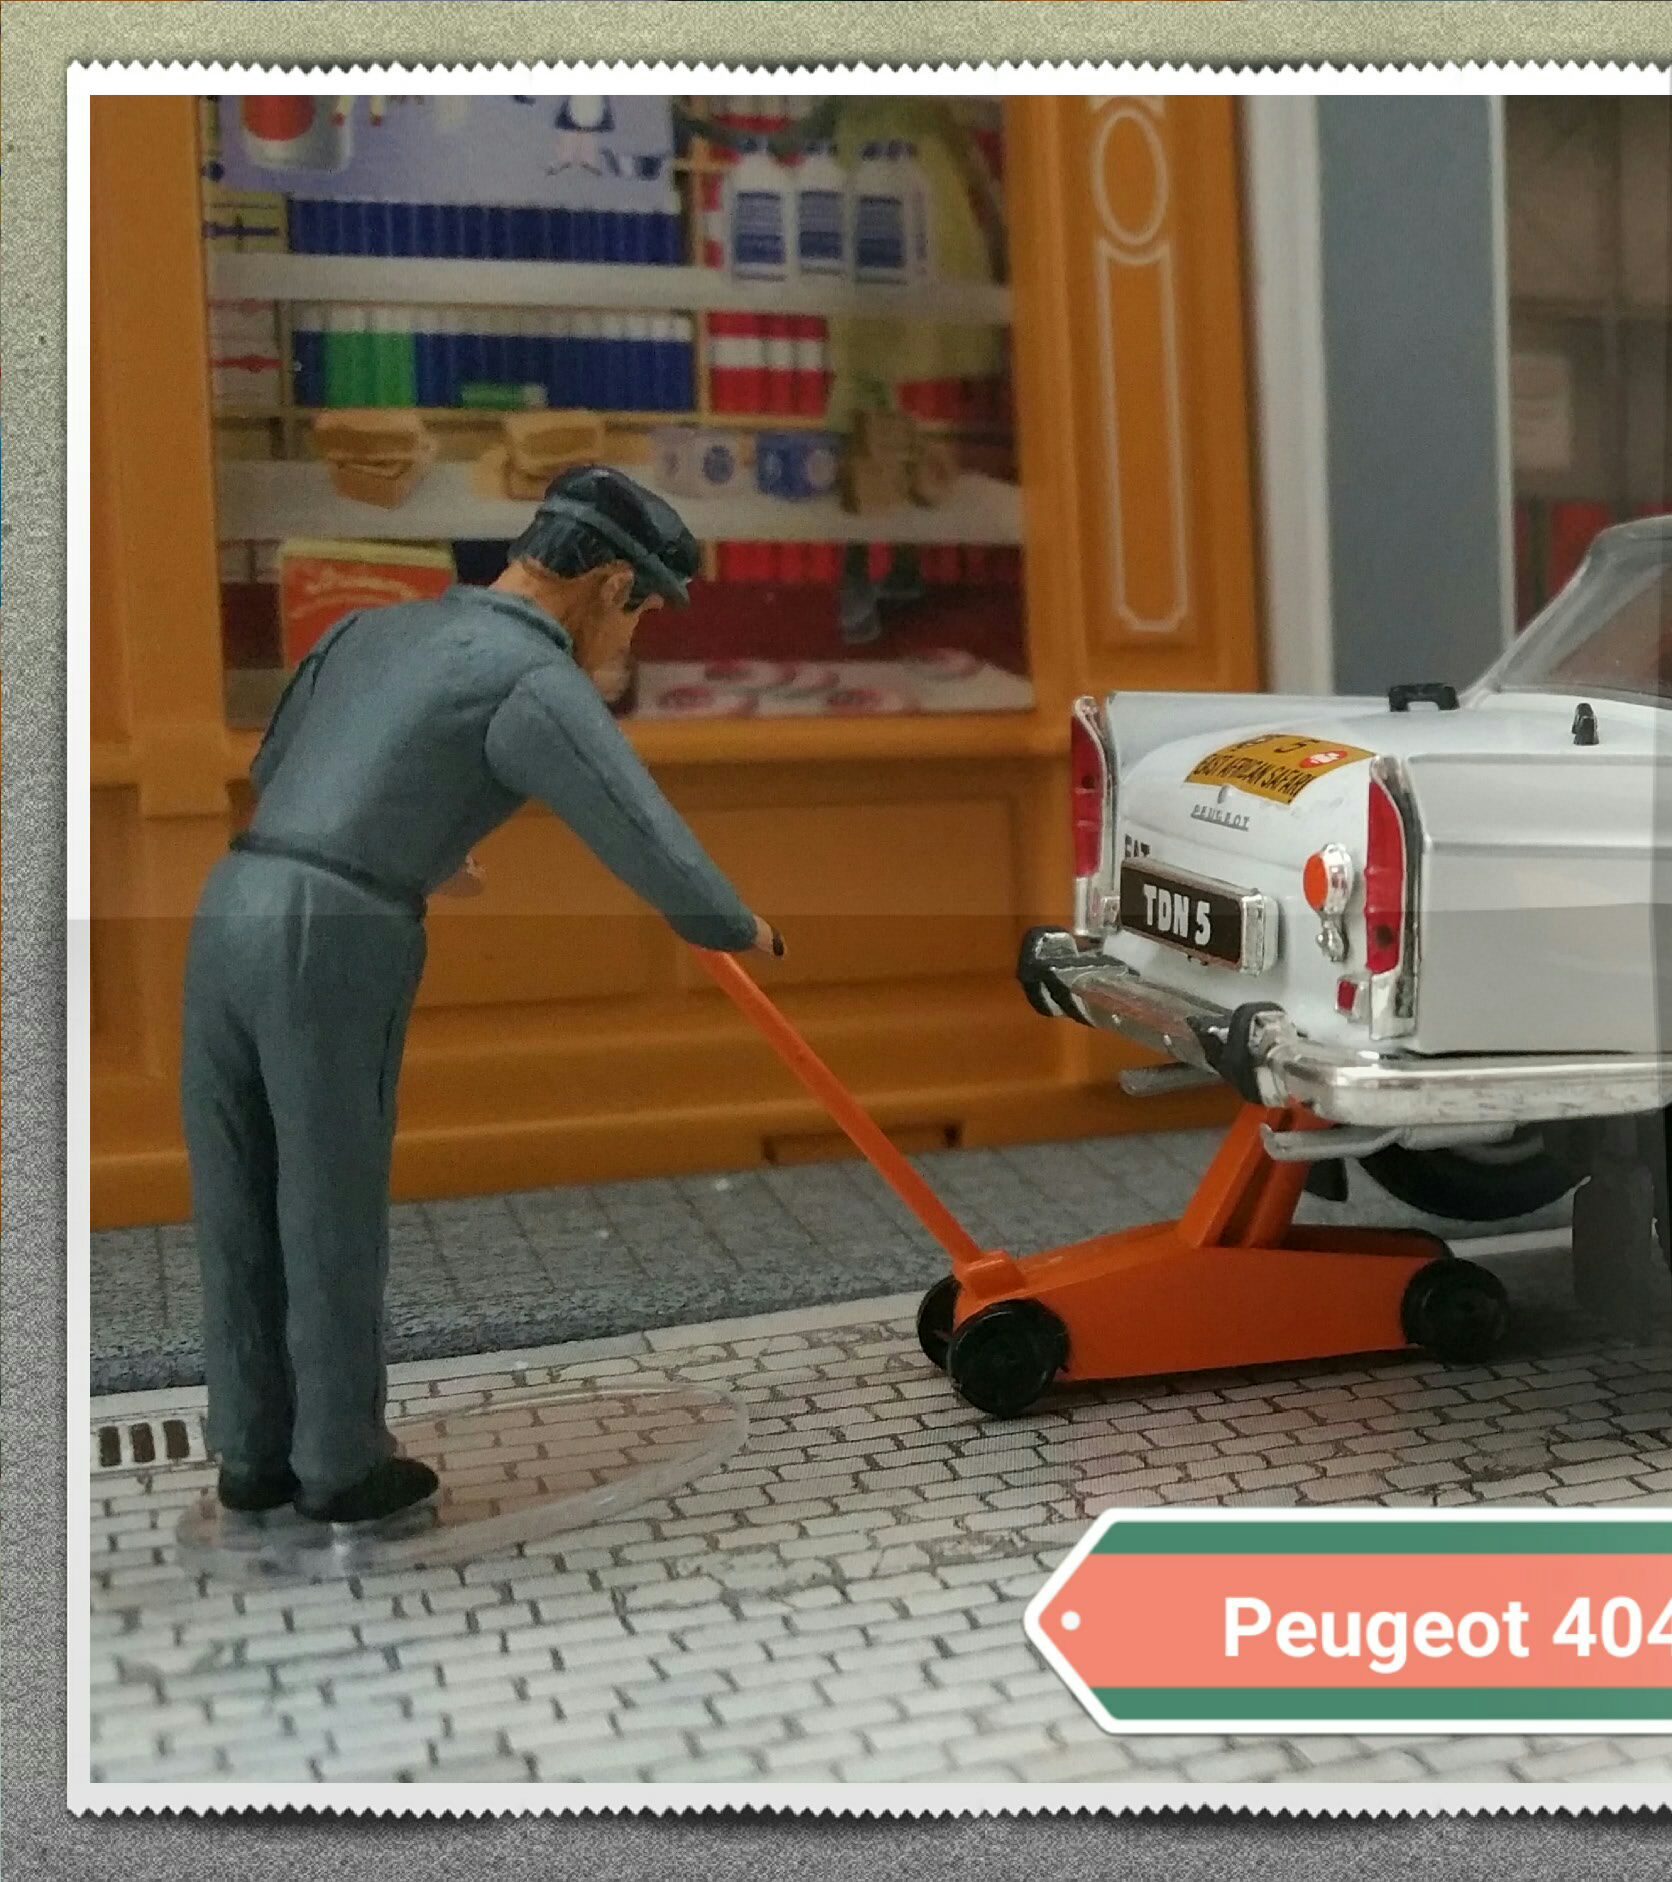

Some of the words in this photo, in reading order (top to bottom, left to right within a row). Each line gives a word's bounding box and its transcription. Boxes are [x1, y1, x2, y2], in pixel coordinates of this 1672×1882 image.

[1191, 803, 1251, 829] PEUGEOT
[1143, 883, 1190, 939] TDN
[1194, 899, 1212, 946] 5
